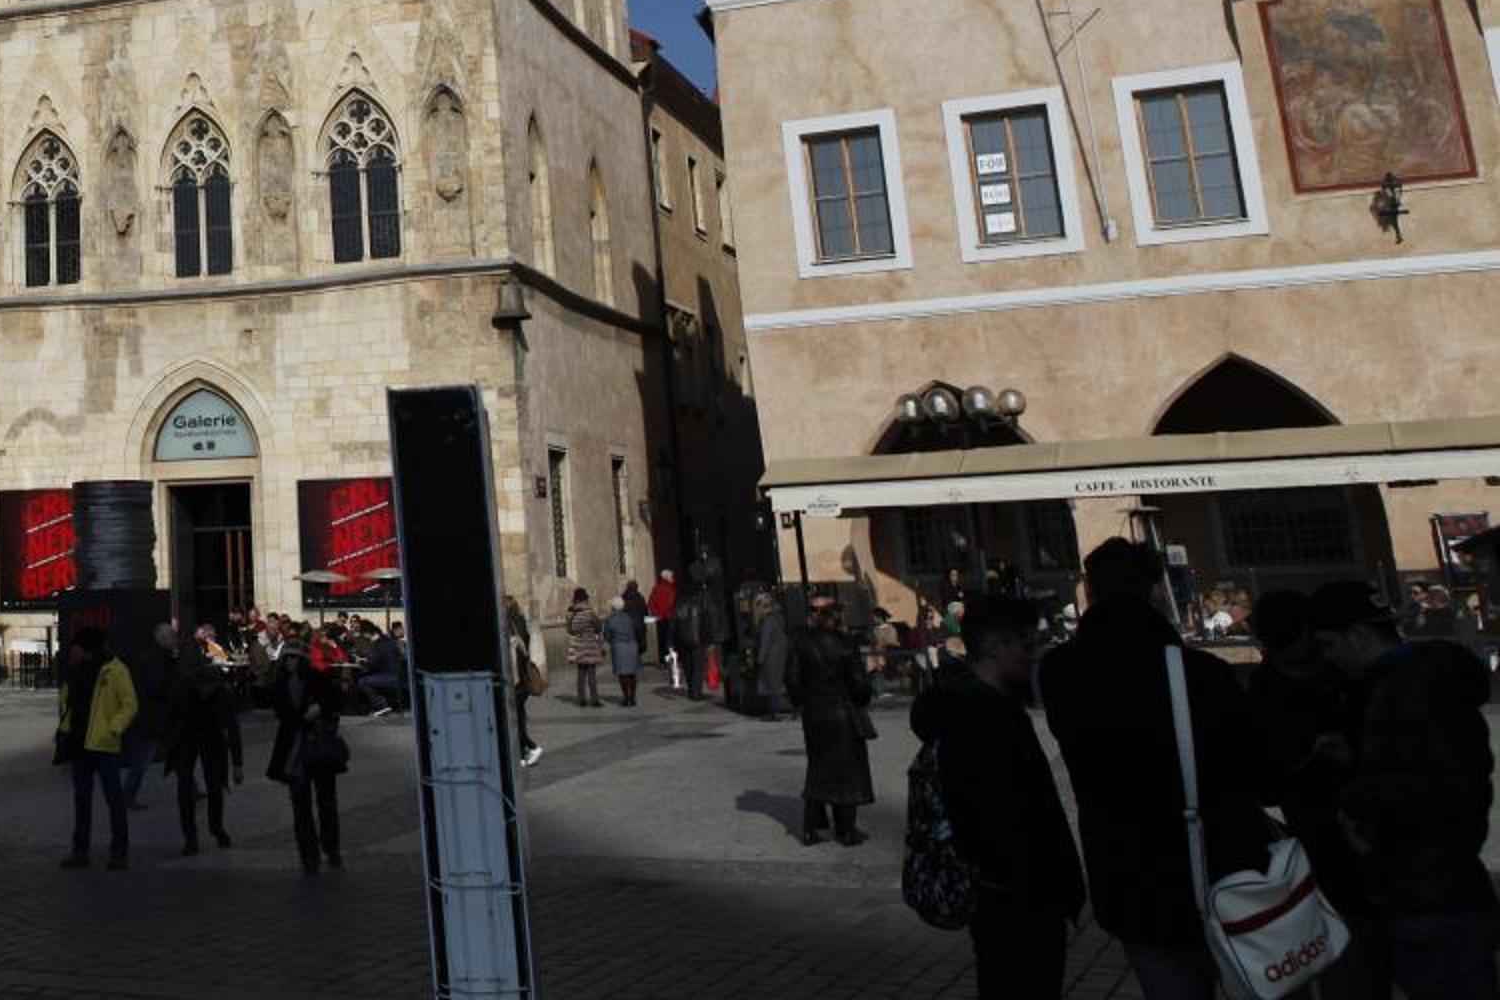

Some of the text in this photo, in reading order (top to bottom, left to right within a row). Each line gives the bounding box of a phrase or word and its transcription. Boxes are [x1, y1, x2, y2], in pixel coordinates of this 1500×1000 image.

[173, 414, 236, 429] Galerie
[1131, 475, 1216, 489] RISTORANTE
[1265, 938, 1326, 982] adidas
